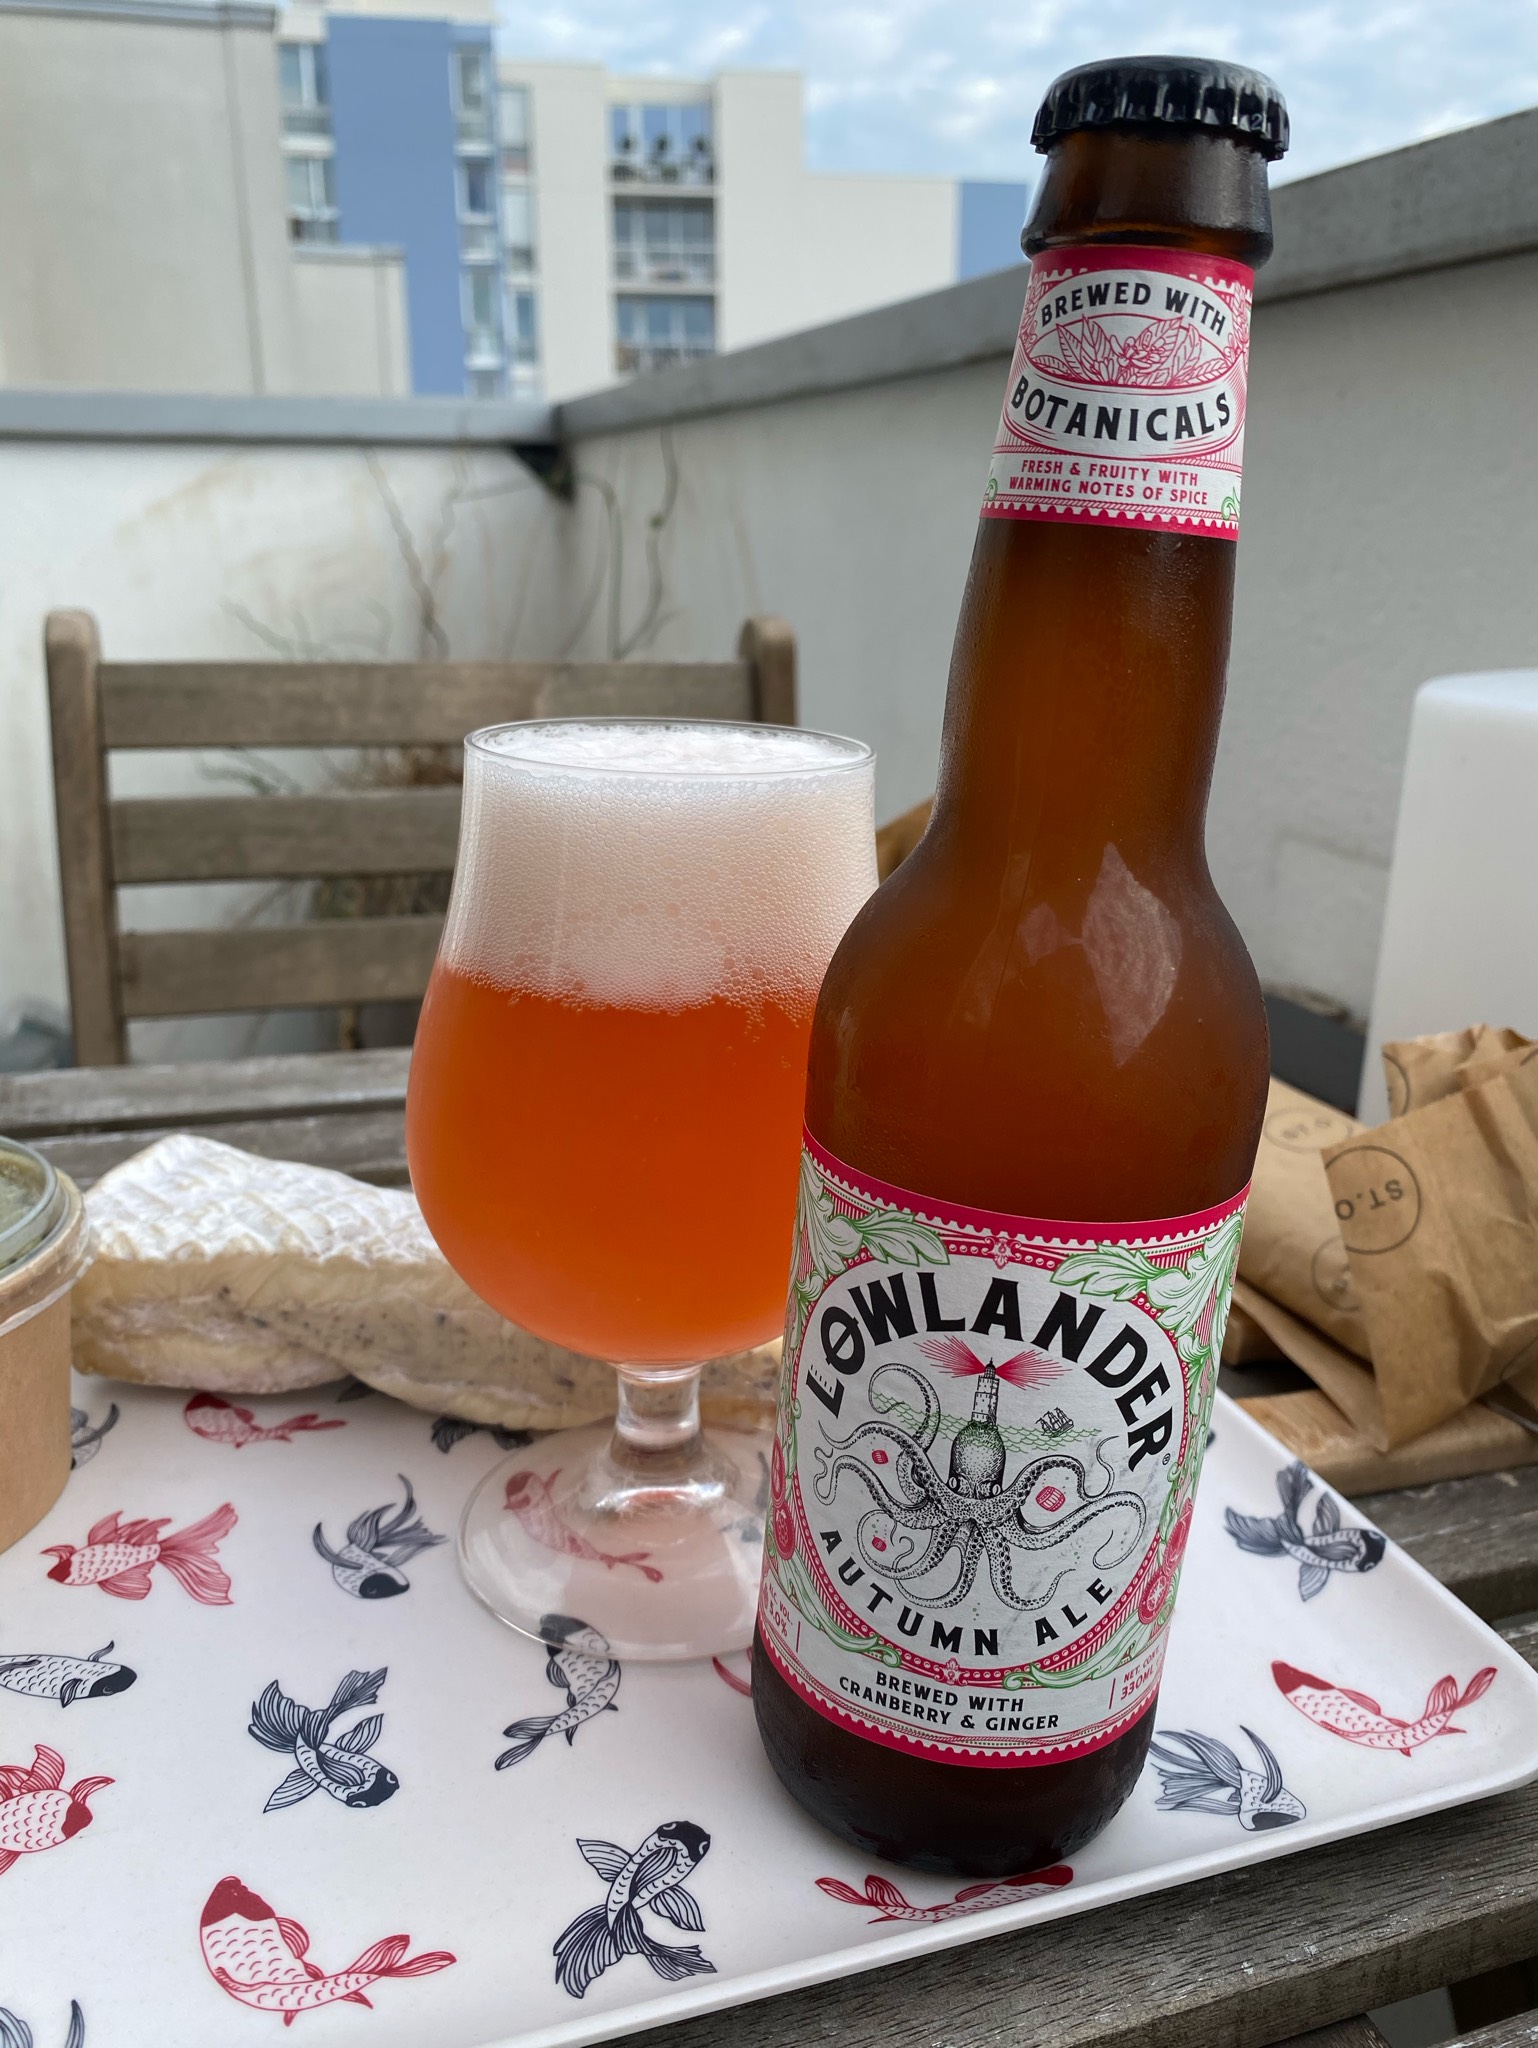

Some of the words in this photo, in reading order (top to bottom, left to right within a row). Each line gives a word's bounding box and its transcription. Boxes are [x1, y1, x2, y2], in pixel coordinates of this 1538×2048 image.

[1041, 282, 1151, 327] BREWED
[1164, 287, 1226, 336] WITH
[1010, 375, 1231, 441] BOTANICALS
[1009, 476, 1071, 493] WARMING
[1078, 481, 1135, 498] NOTES
[1143, 487, 1163, 500] OF
[1171, 489, 1208, 505] SPICE
[1021, 460, 1063, 475] FRESH
[1069, 462, 1081, 475] &
[1089, 463, 1150, 481] FRUITY
[1158, 470, 1198, 486] WITH
[820, 1530, 999, 1656] AUTUMN
[1034, 1577, 1113, 1647] ALE
[839, 1676, 952, 1726] CRANBERRY
[960, 1714, 976, 1730] &
[985, 1714, 1060, 1732] GINGER
[876, 1671, 959, 1707] BREWED
[968, 1695, 1024, 1713] WITH
[1121, 1664, 1153, 1701] 330ML
